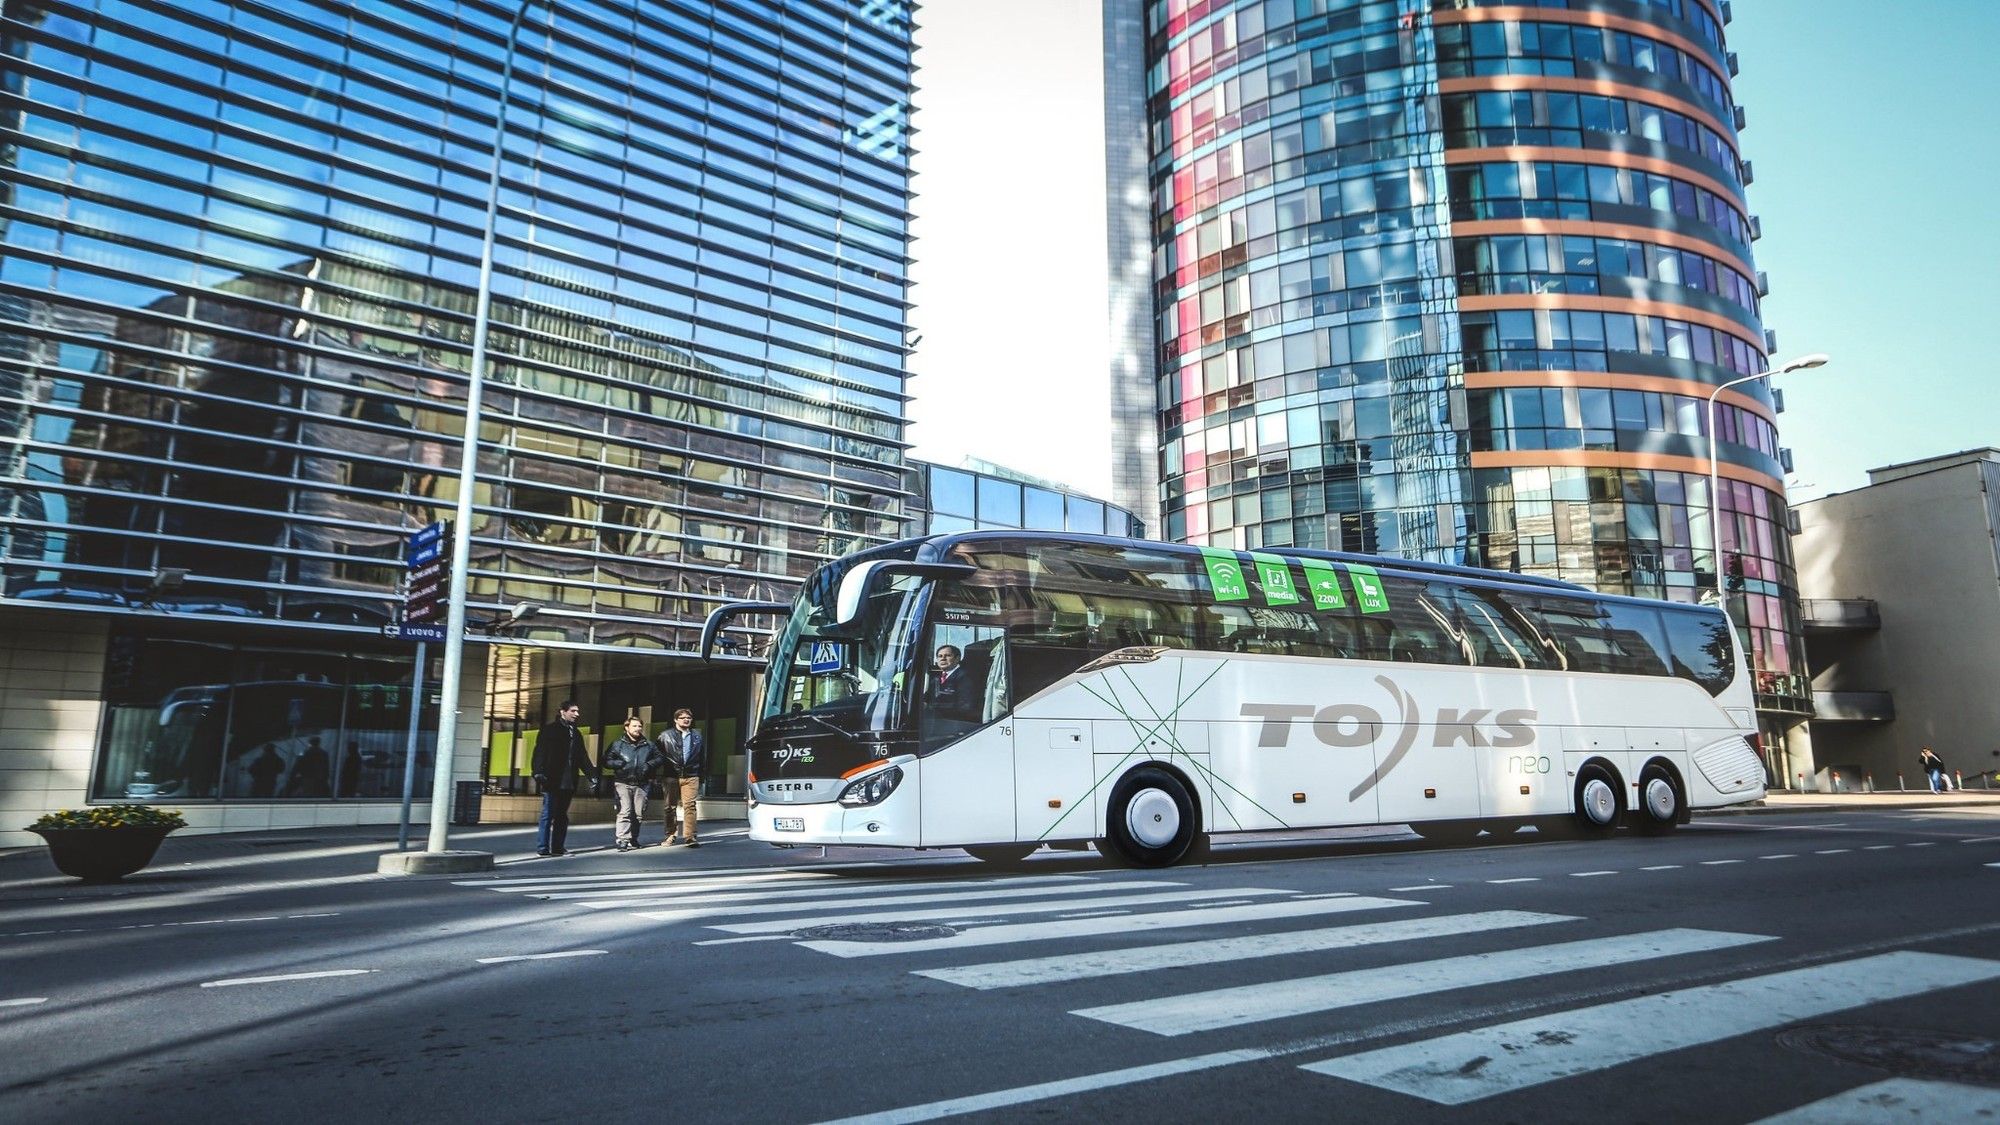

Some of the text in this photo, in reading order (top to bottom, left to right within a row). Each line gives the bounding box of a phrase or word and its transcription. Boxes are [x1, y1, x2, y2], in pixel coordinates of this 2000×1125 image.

[1217, 586, 1240, 595] wi-fi
[1267, 591, 1294, 600] media
[1317, 594, 1338, 604] 220V
[406, 627, 434, 637] LVOVO
[1000, 726, 1011, 735] 76
[873, 745, 887, 755] 76
[1509, 755, 1550, 774] neo
[768, 783, 813, 791] SETRA
